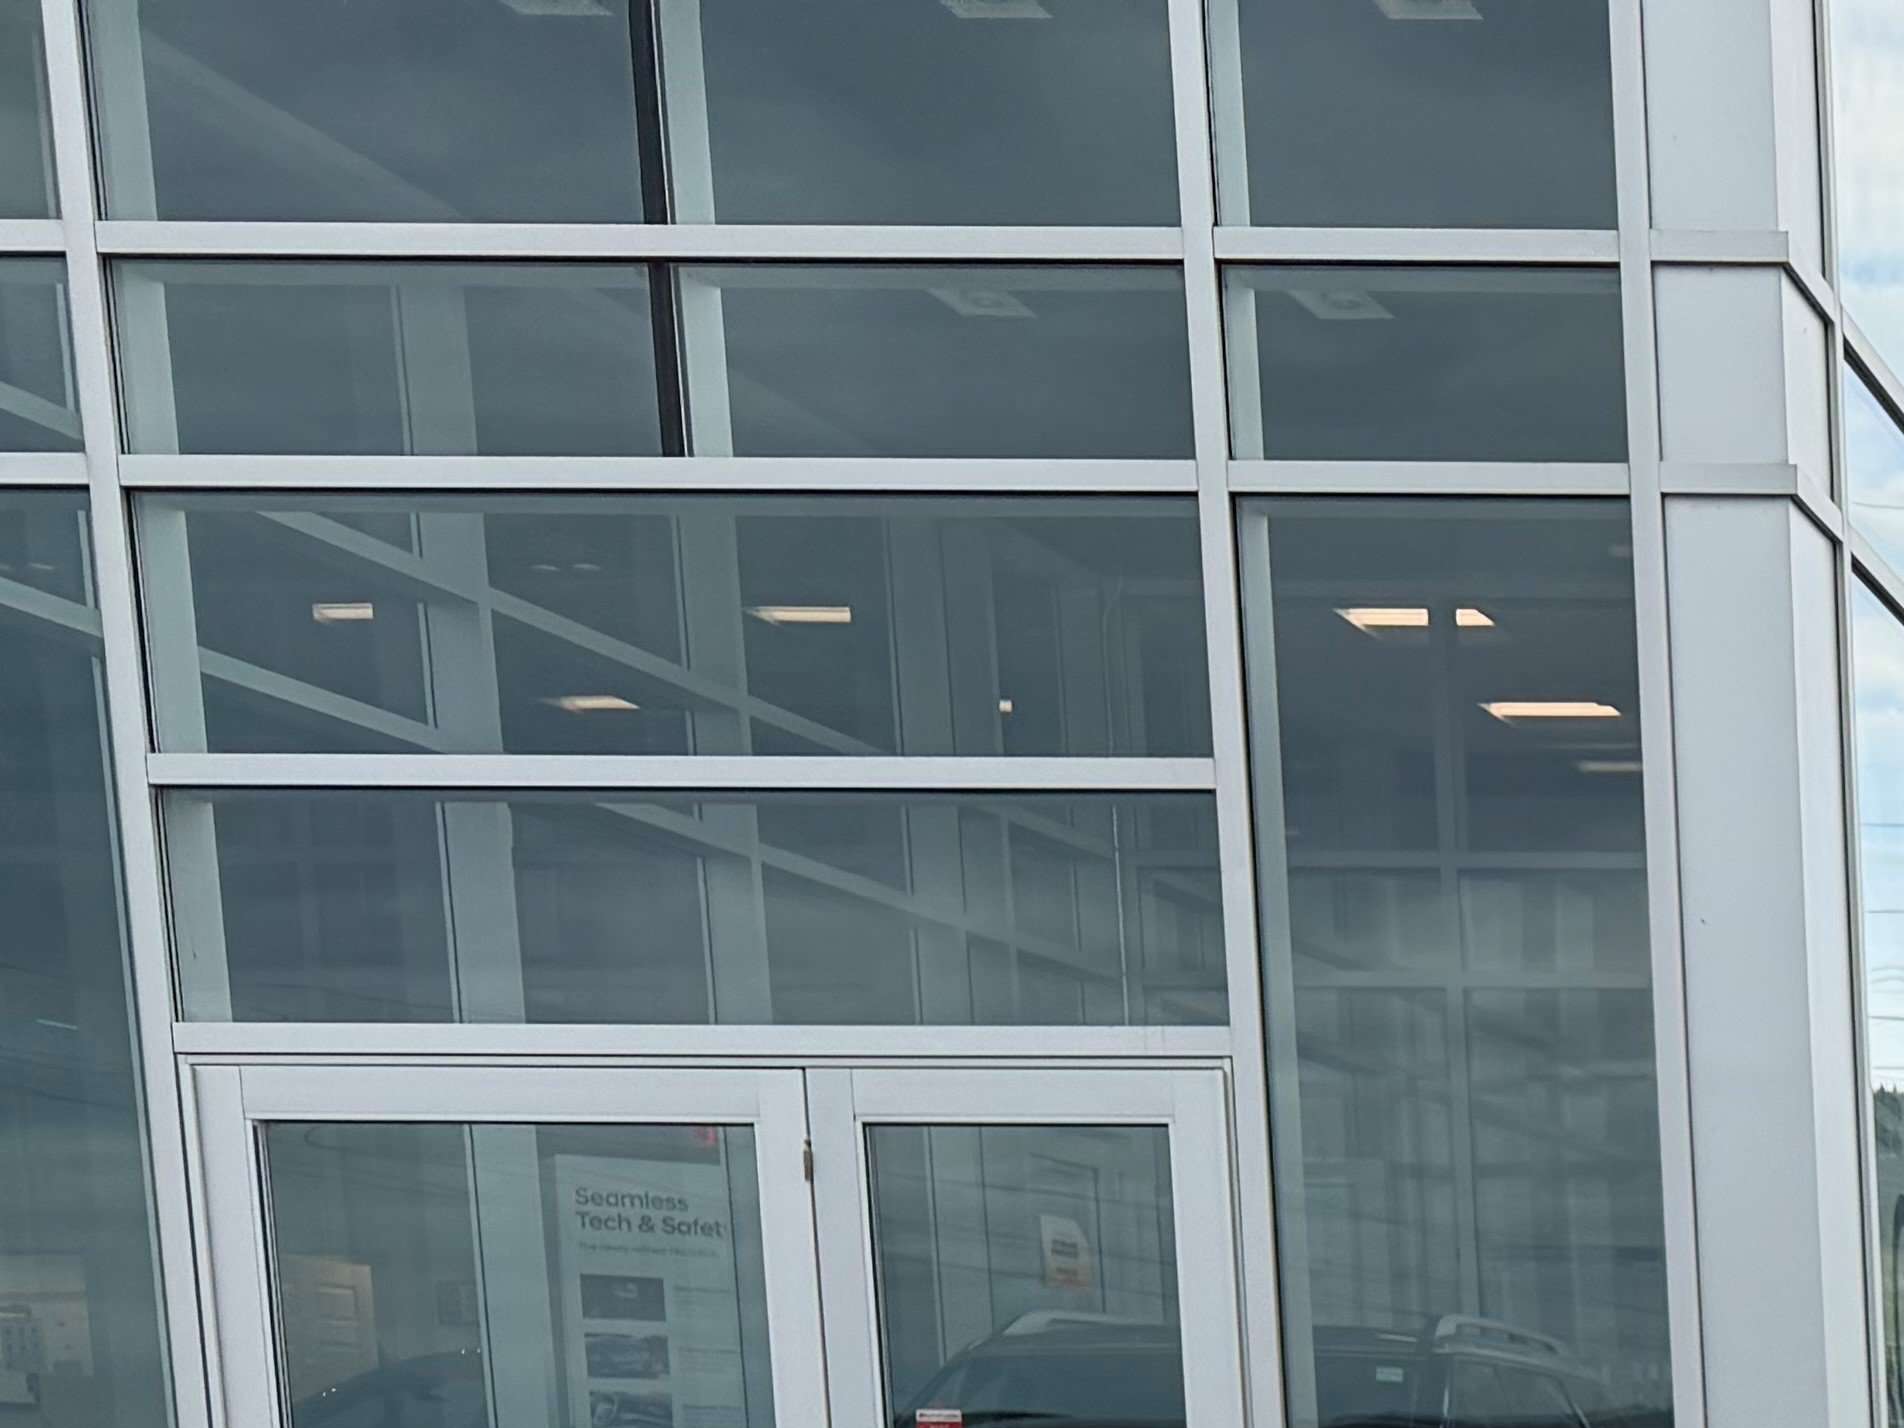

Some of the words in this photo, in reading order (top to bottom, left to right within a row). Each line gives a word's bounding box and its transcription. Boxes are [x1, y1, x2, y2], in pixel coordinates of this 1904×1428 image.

[574, 1186, 689, 1213] Seamless
[574, 1211, 633, 1233] Tech
[637, 1213, 656, 1235] &
[661, 1215, 728, 1239] Safet
